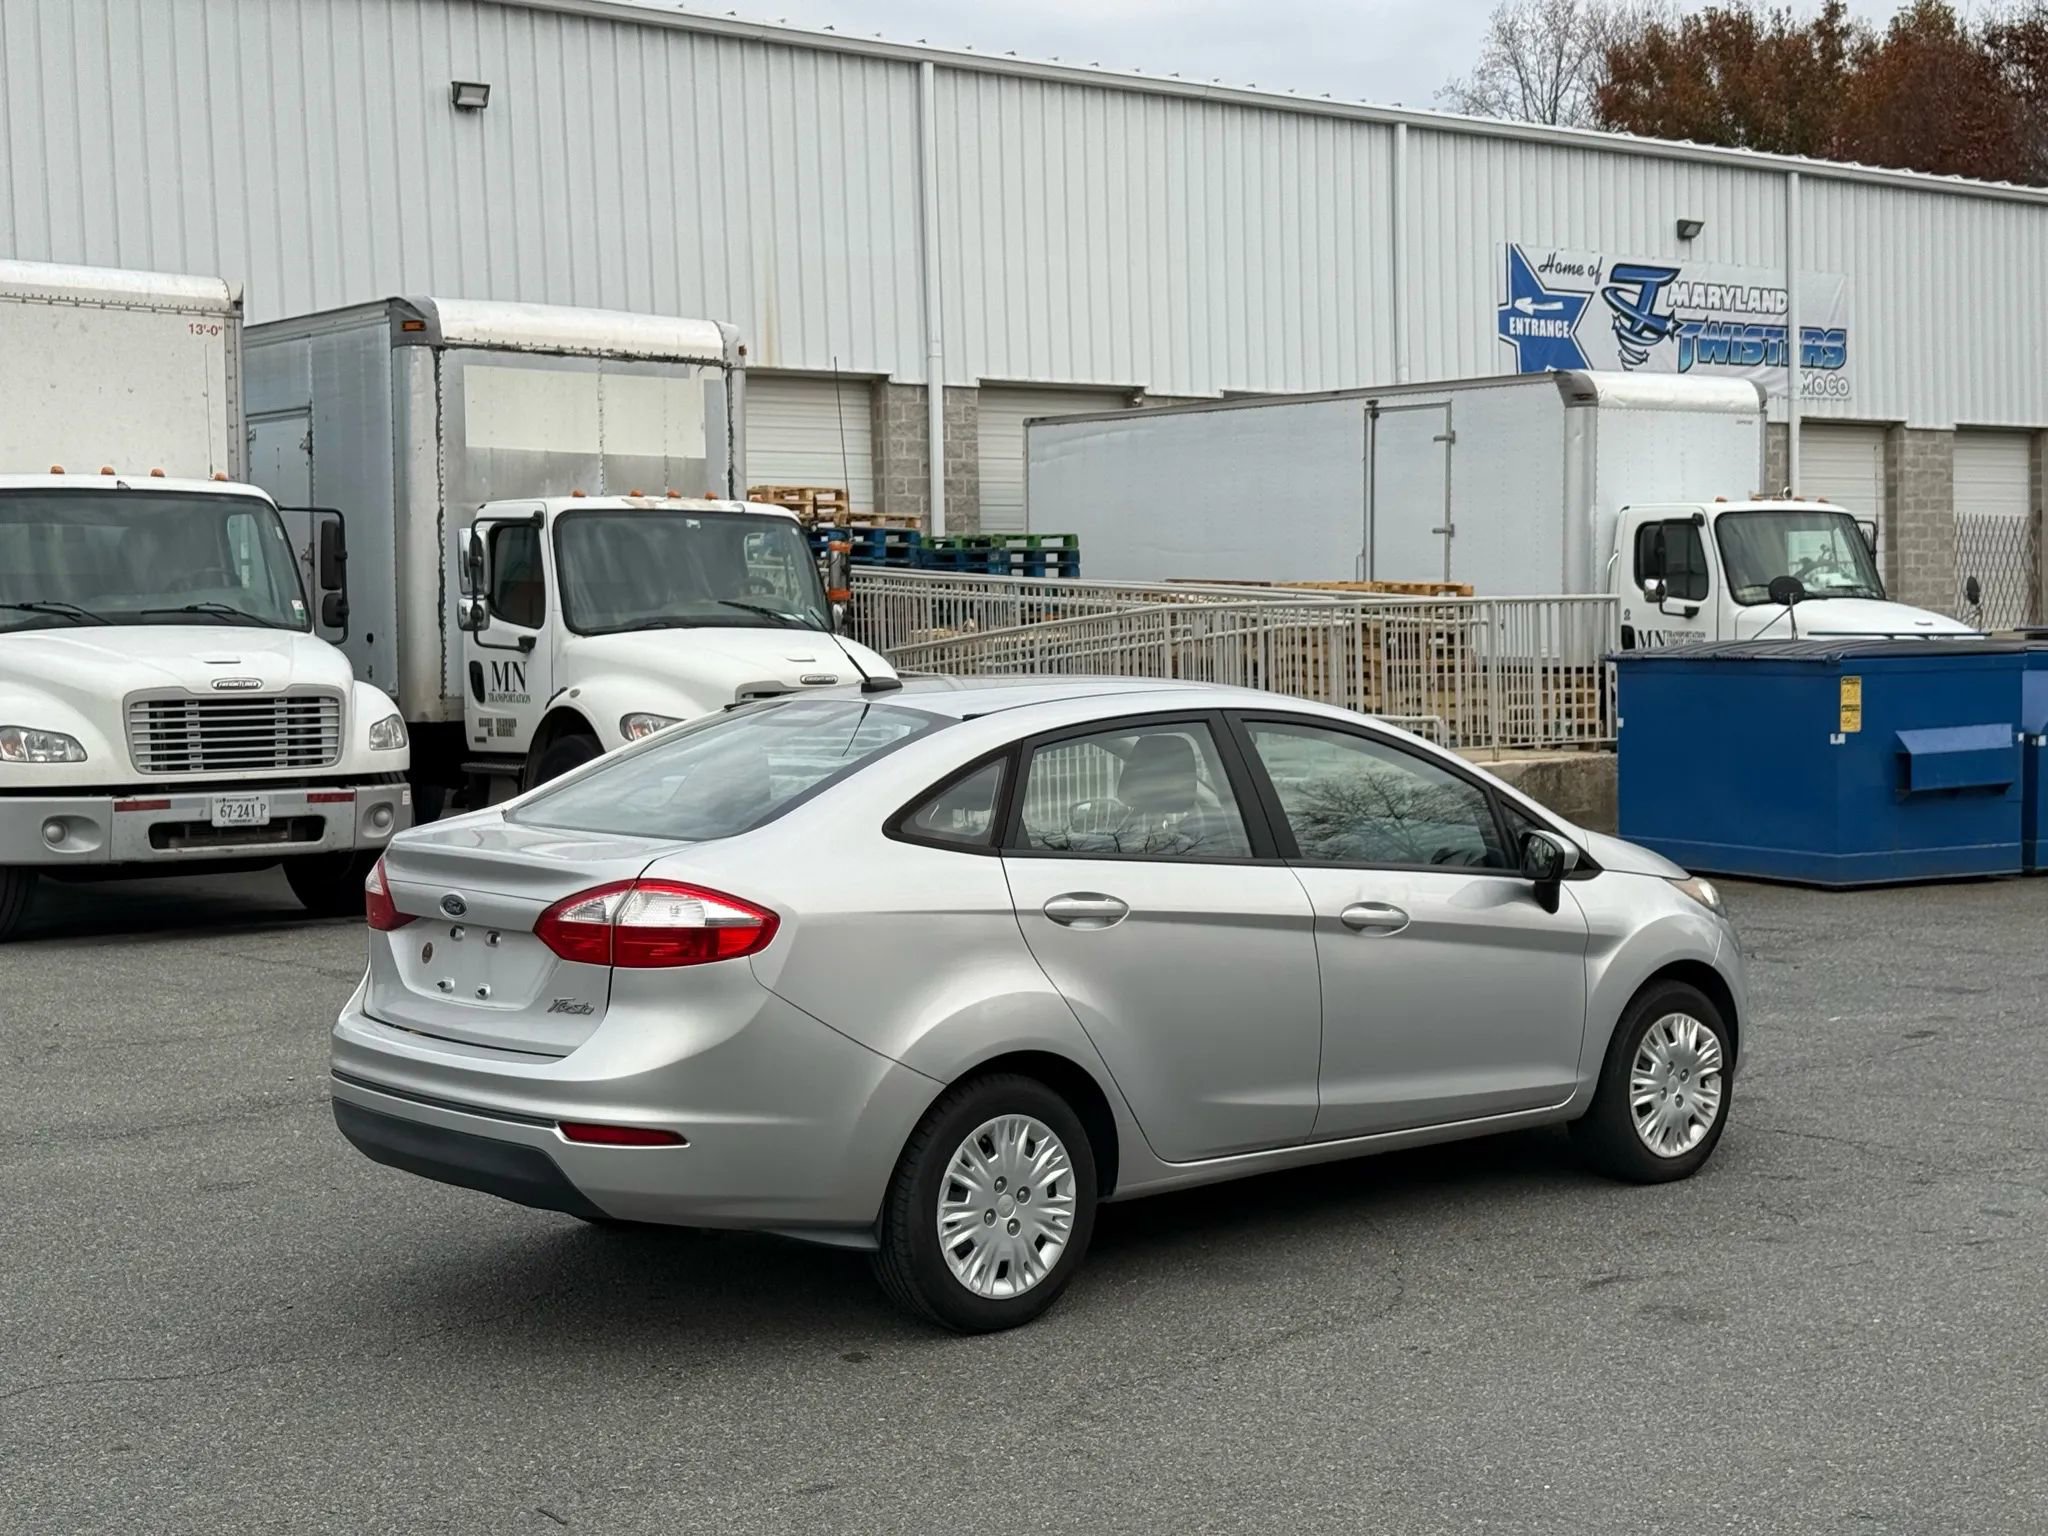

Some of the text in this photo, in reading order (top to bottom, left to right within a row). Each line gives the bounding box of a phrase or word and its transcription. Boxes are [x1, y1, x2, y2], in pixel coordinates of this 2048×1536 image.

[1538, 252, 1603, 286] Home of
[1667, 281, 1788, 315] MARYLAND
[1509, 317, 1570, 338] ENTRANCE
[1638, 630, 1666, 648] MN
[490, 660, 527, 692] MN
[488, 692, 531, 704] TRANSPORTATION
[547, 997, 595, 1015] Fiesta
